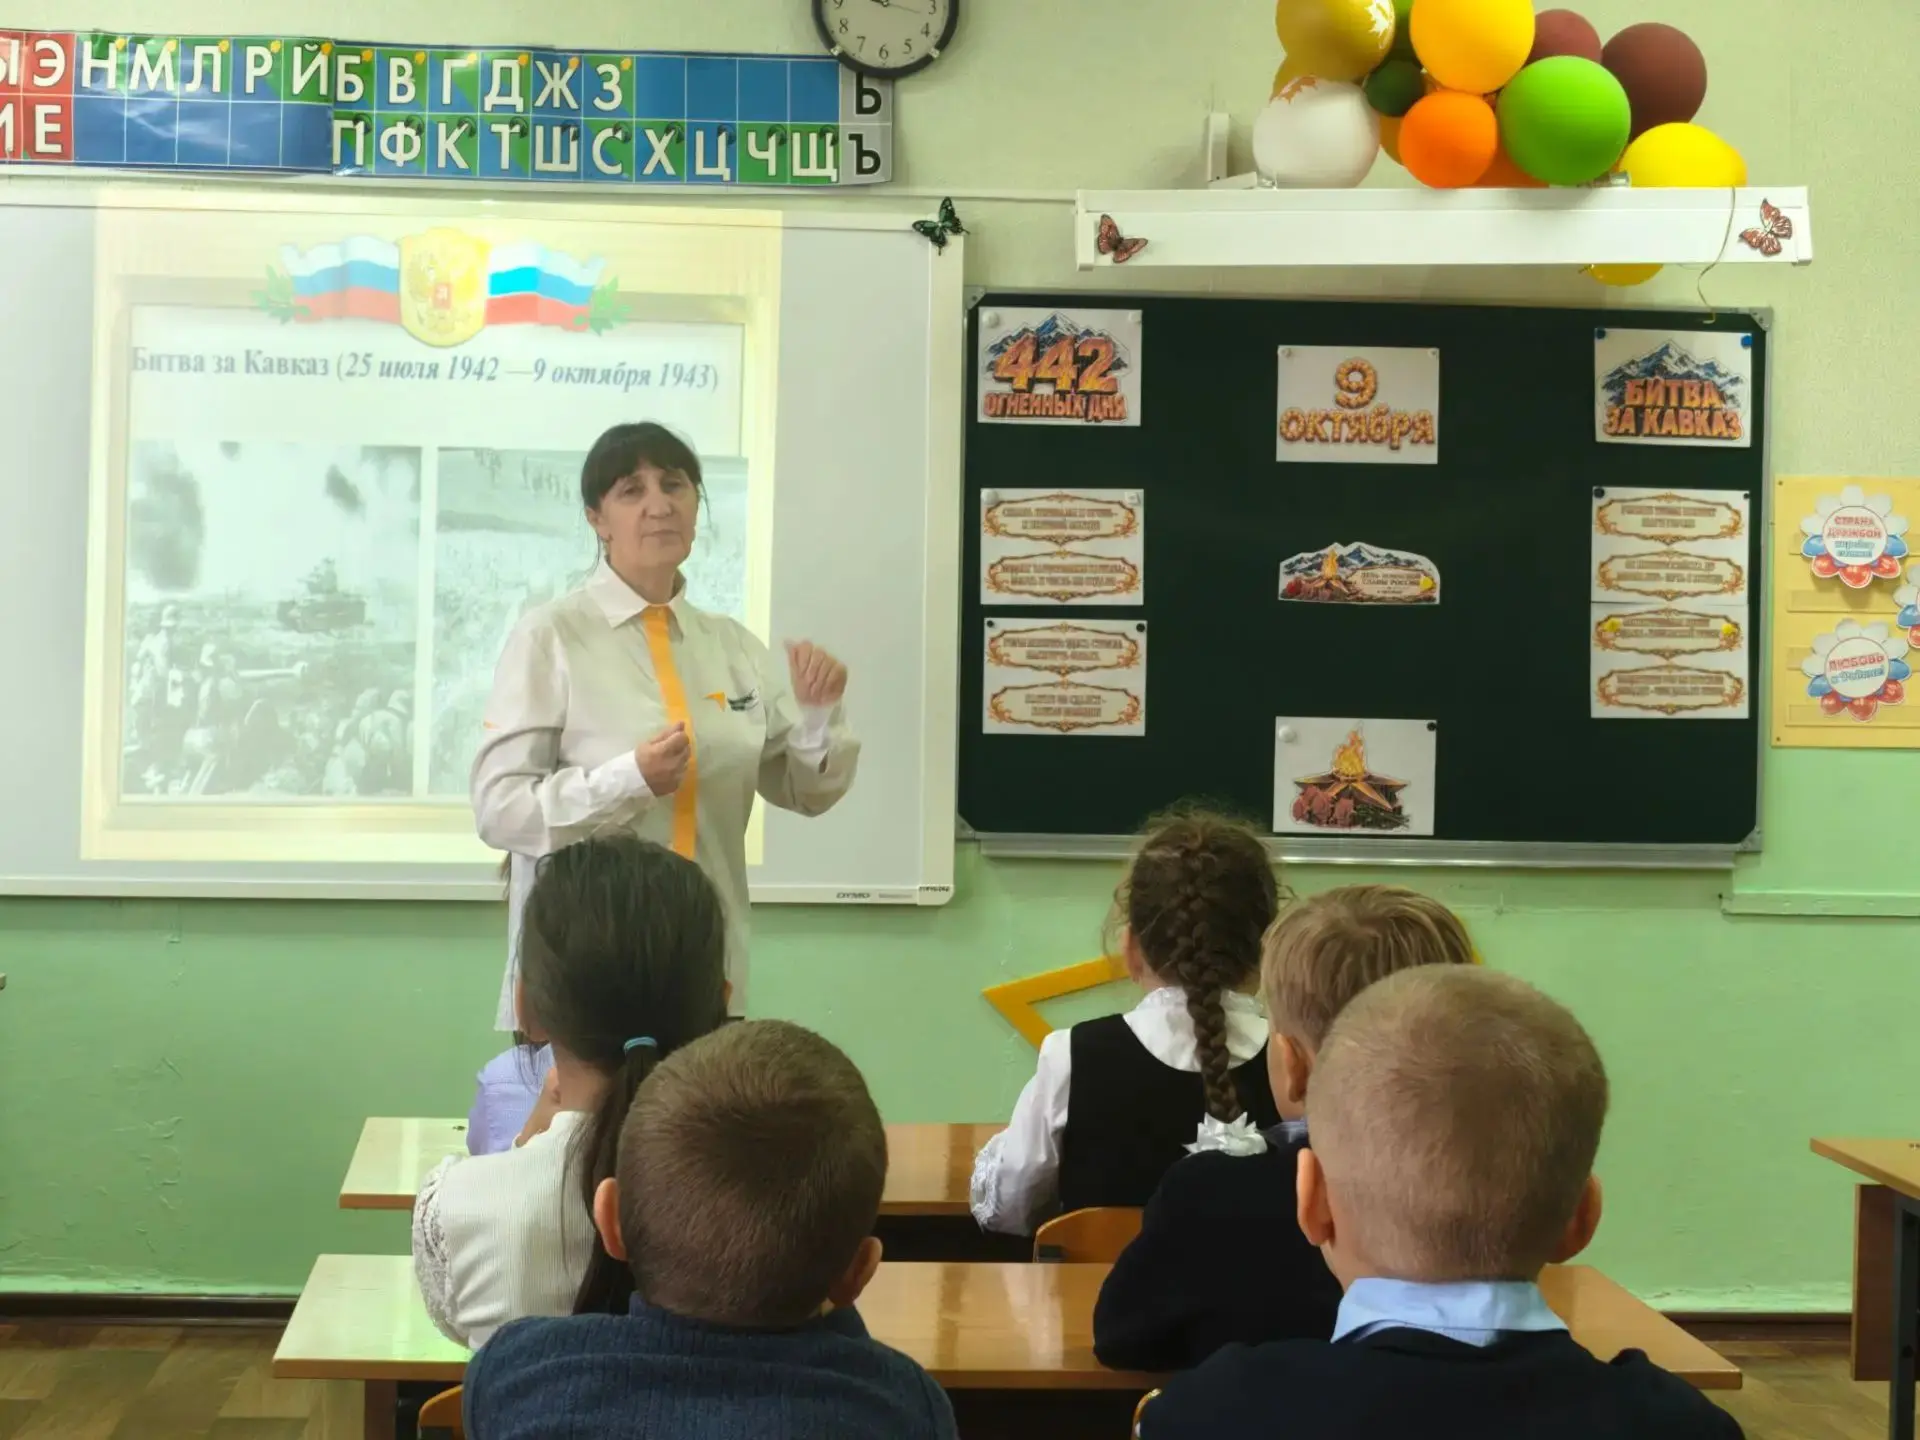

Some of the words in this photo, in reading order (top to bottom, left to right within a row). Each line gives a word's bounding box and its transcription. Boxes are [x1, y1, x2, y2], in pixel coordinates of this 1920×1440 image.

[928, 0, 937, 15] 3
[839, 18, 849, 34] 8
[920, 22, 930, 37] 4
[857, 36, 866, 52] 7
[879, 44, 889, 60] 6
[902, 38, 912, 54] 5
[33, 39, 66, 87] Э
[81, 40, 117, 89] Н
[130, 44, 176, 92] М
[185, 45, 222, 94] Л
[245, 46, 273, 94] Р
[292, 42, 328, 96] Й
[337, 55, 365, 102] Б
[388, 57, 416, 104] В
[442, 57, 468, 105] Г
[484, 59, 524, 112] Д
[534, 60, 579, 109] Ж
[593, 62, 623, 113] З
[35, 104, 62, 153] Е
[333, 119, 364, 165] П
[379, 122, 421, 167] Ф
[438, 123, 470, 169] К
[491, 123, 522, 170] Т
[534, 125, 578, 172] Ш
[592, 127, 623, 175] С
[641, 128, 677, 176] Х
[695, 129, 731, 181] Ц
[748, 131, 777, 176] Ч
[791, 132, 838, 182] Щ
[848, 133, 881, 175] Ъ
[131, 346, 205, 374] Битва
[212, 354, 237, 375] за
[244, 348, 329, 377] Кавказ
[336, 352, 373, 382] (25
[378, 360, 440, 380] июля
[447, 355, 499, 382] 1942
[551, 361, 652, 393] октября
[658, 362, 719, 393] 1943)
[993, 334, 1118, 394] 442
[1334, 358, 1378, 409] 9
[1623, 378, 1726, 409] БИТВА
[984, 393, 1085, 418] ОГНЕННЫХ
[1604, 405, 1637, 436] ЗА
[1643, 407, 1742, 440] КАВКАЗ
